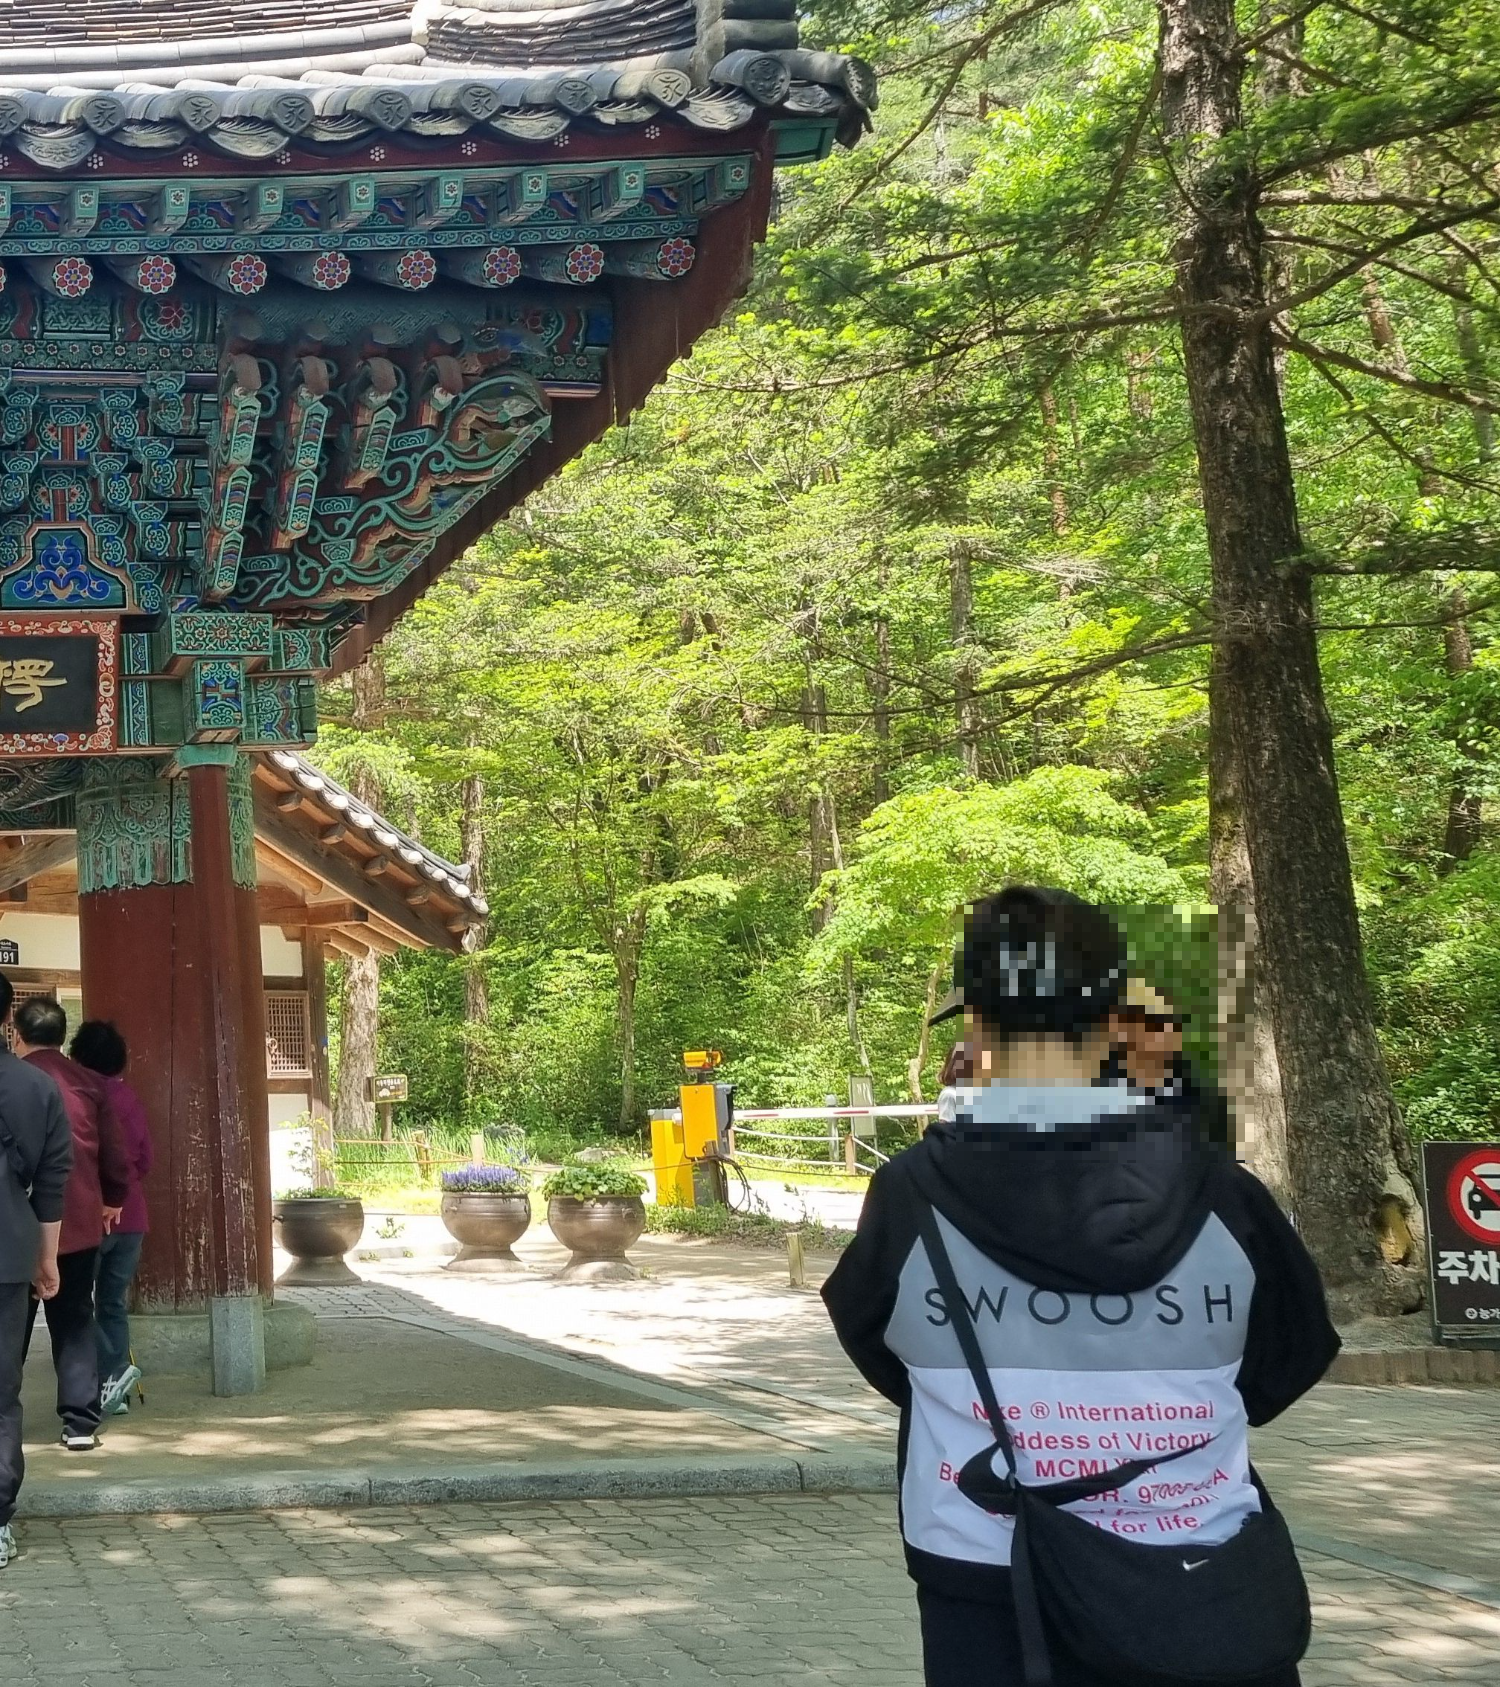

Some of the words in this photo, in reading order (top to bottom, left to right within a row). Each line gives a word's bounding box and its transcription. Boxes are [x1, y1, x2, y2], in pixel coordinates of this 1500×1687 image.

[1437, 1250, 1500, 1285] 주차
[924, 1284, 1234, 1327] SWOOSH
[972, 1401, 1021, 1420] Ne
[1057, 1400, 1215, 1422] International
[990, 1430, 1091, 1450] ddess
[1098, 1432, 1121, 1450] of
[1111, 1519, 1148, 1534] for
